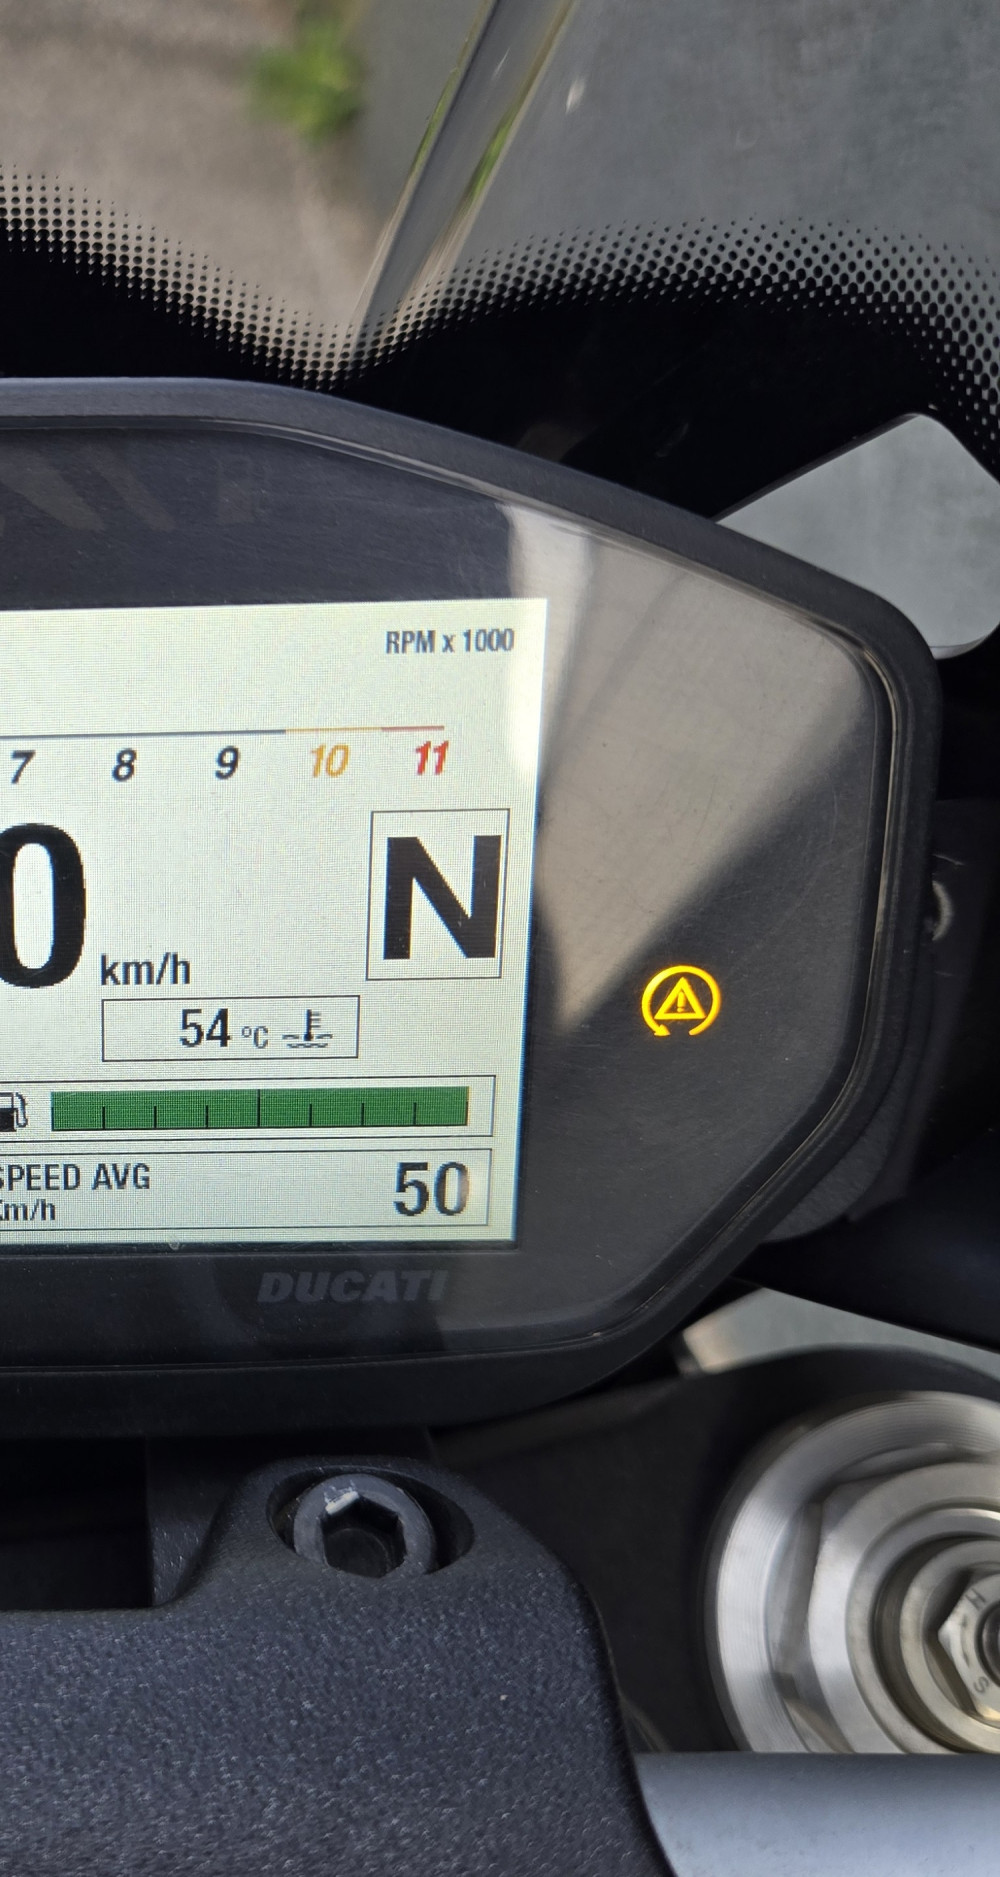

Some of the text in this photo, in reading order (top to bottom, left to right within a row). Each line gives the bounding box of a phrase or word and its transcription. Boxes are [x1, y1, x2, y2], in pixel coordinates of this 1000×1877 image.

[385, 628, 515, 655] RPM x 1000
[10, 750, 36, 784] 7
[111, 748, 138, 782] 8
[214, 746, 241, 780] 9
[311, 744, 350, 778] 10
[415, 740, 450, 776] 11
[383, 835, 502, 960] N
[100, 952, 192, 986] km/h
[179, 1008, 231, 1048] 54
[91, 1162, 151, 1190] AVG
[393, 1160, 470, 1217] 50
[257, 1269, 449, 1304] DUCATI
